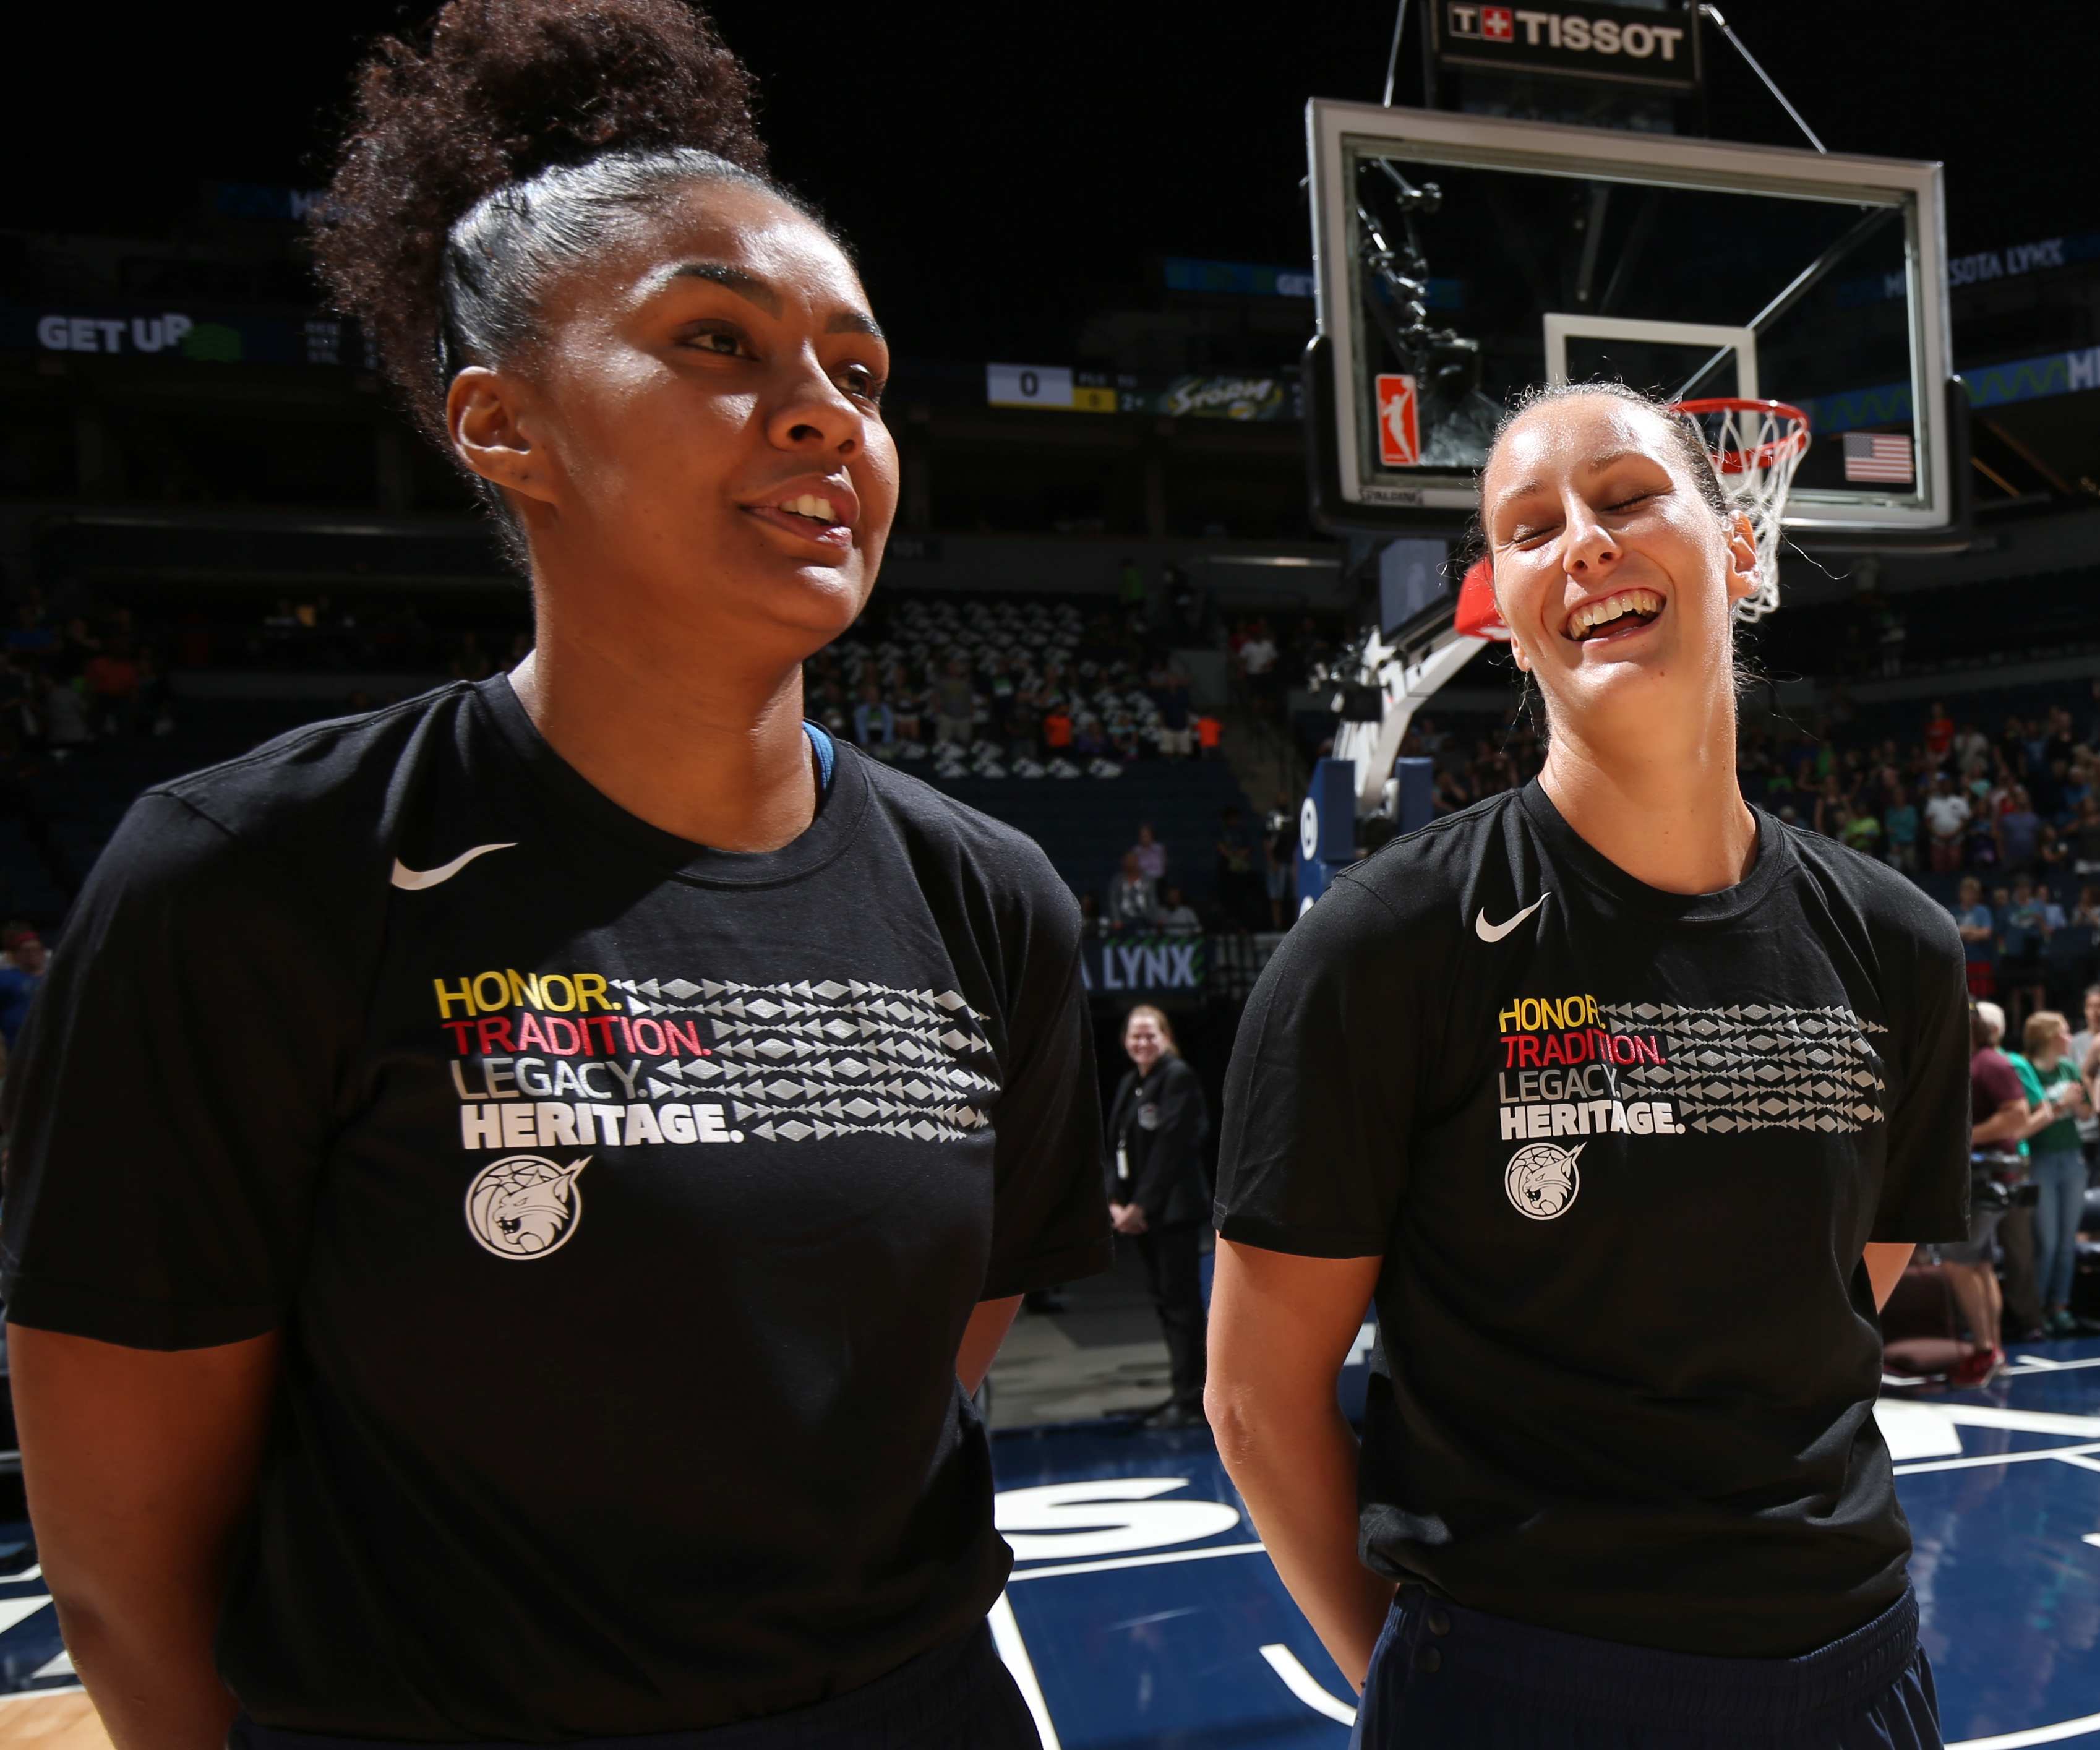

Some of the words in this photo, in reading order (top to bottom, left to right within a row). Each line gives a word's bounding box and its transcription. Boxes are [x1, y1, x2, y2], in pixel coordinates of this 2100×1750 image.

[1515, 10, 1683, 61] TISSOT
[2006, 238, 2066, 276] LYNX
[37, 315, 126, 353] GET
[131, 312, 193, 352] UP
[1021, 371, 1038, 397] 0
[1102, 945, 1196, 989] LYNX
[434, 969, 623, 1018] HONOR.
[1498, 993, 1608, 1032] HONOR.
[441, 1012, 713, 1057] TRADITION.
[1500, 1028, 1668, 1068] TRADITION.
[450, 1057, 649, 1100] LEGACY.
[1499, 1063, 1621, 1104] LEGACY.
[460, 1101, 745, 1150] HERITAGE.
[1499, 1099, 1687, 1141] HERITAGE.
